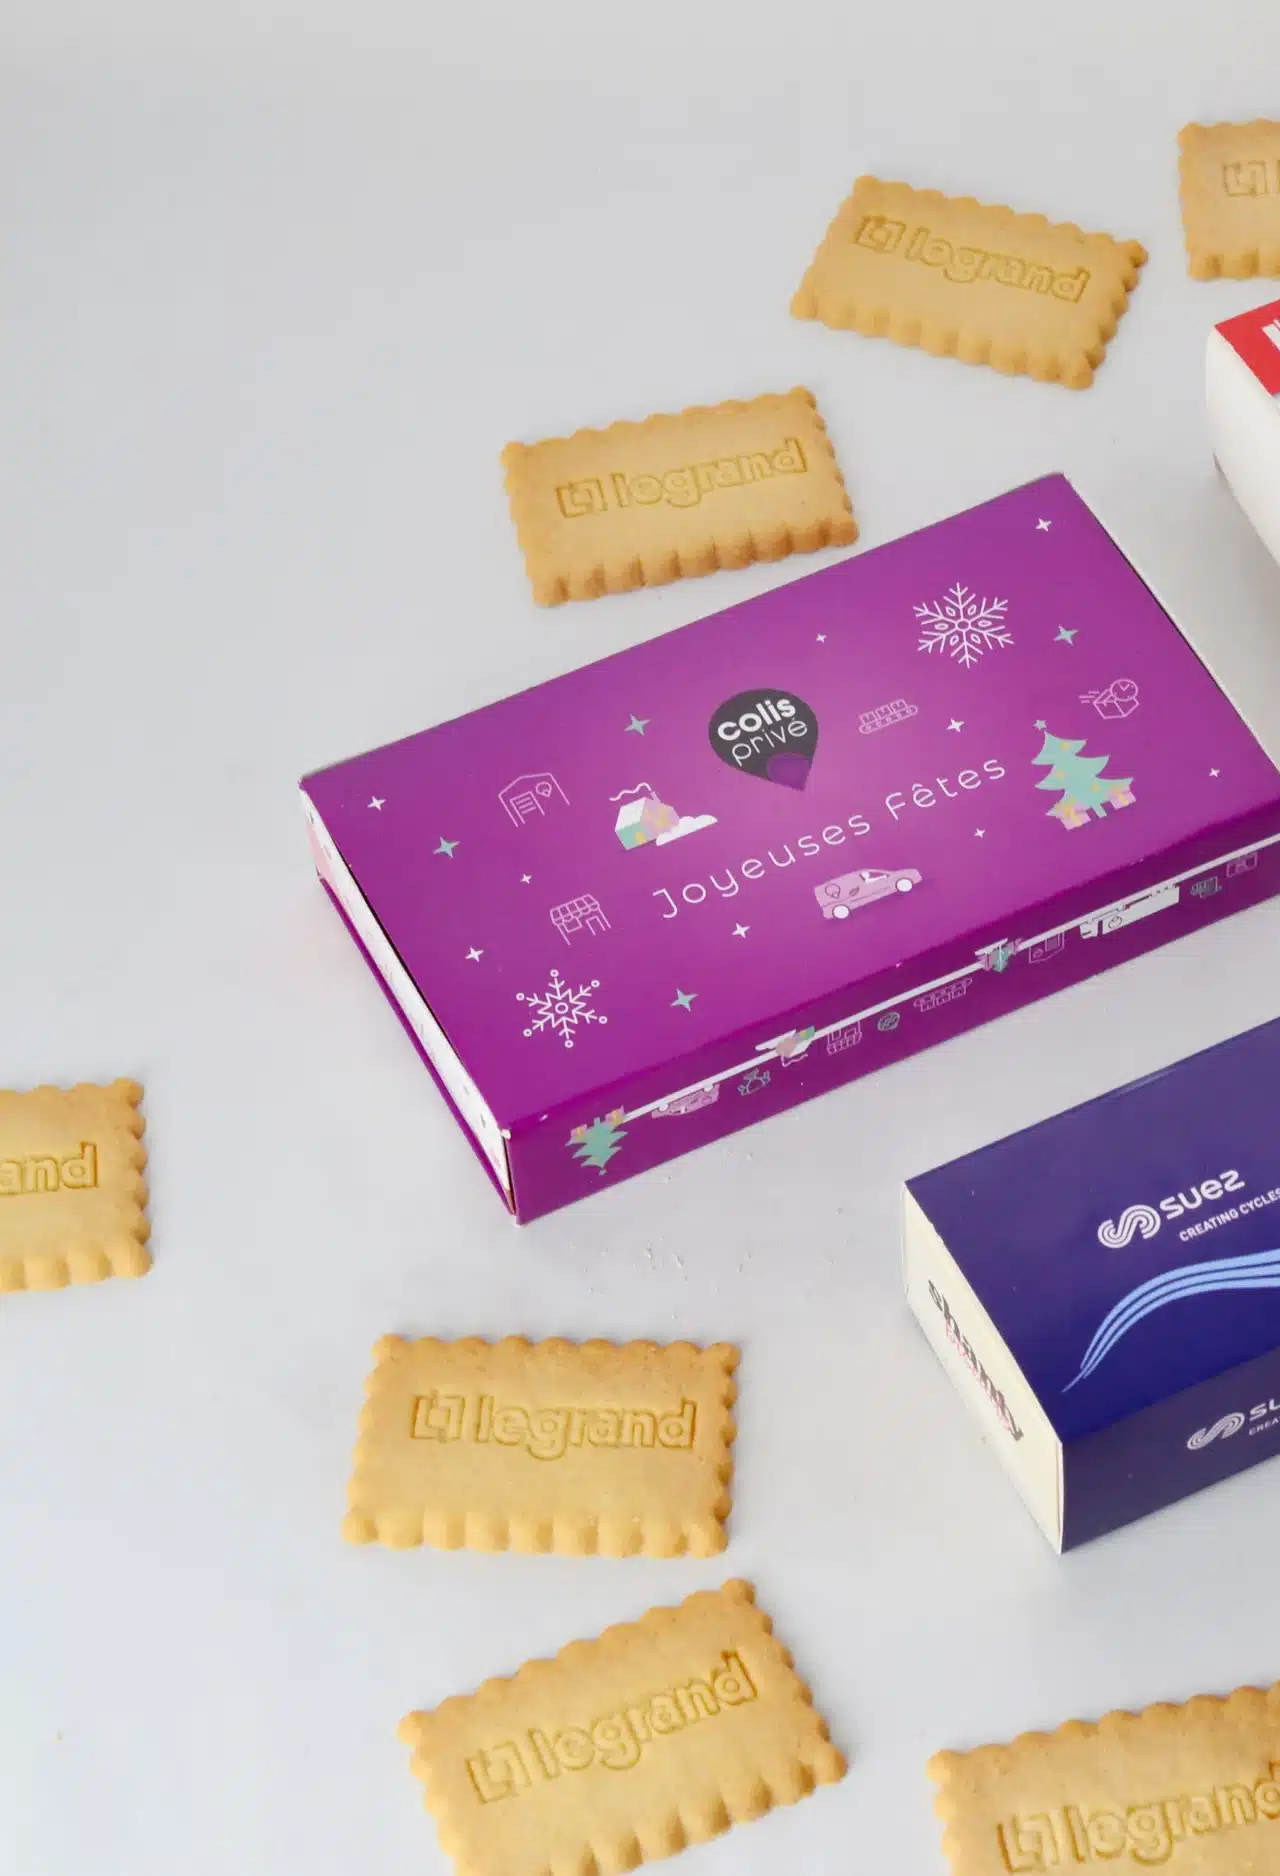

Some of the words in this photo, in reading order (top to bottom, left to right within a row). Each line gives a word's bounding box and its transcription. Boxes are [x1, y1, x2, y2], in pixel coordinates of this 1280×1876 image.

[904, 227, 1091, 303] legrand
[610, 437, 808, 509] legrand
[716, 696, 797, 742] colis
[731, 718, 809, 767] privé
[652, 813, 871, 919] Joyeuses
[1178, 1207, 1240, 1242] CREATING
[476, 1394, 697, 1462] legrand
[527, 1648, 759, 1782] legrand
